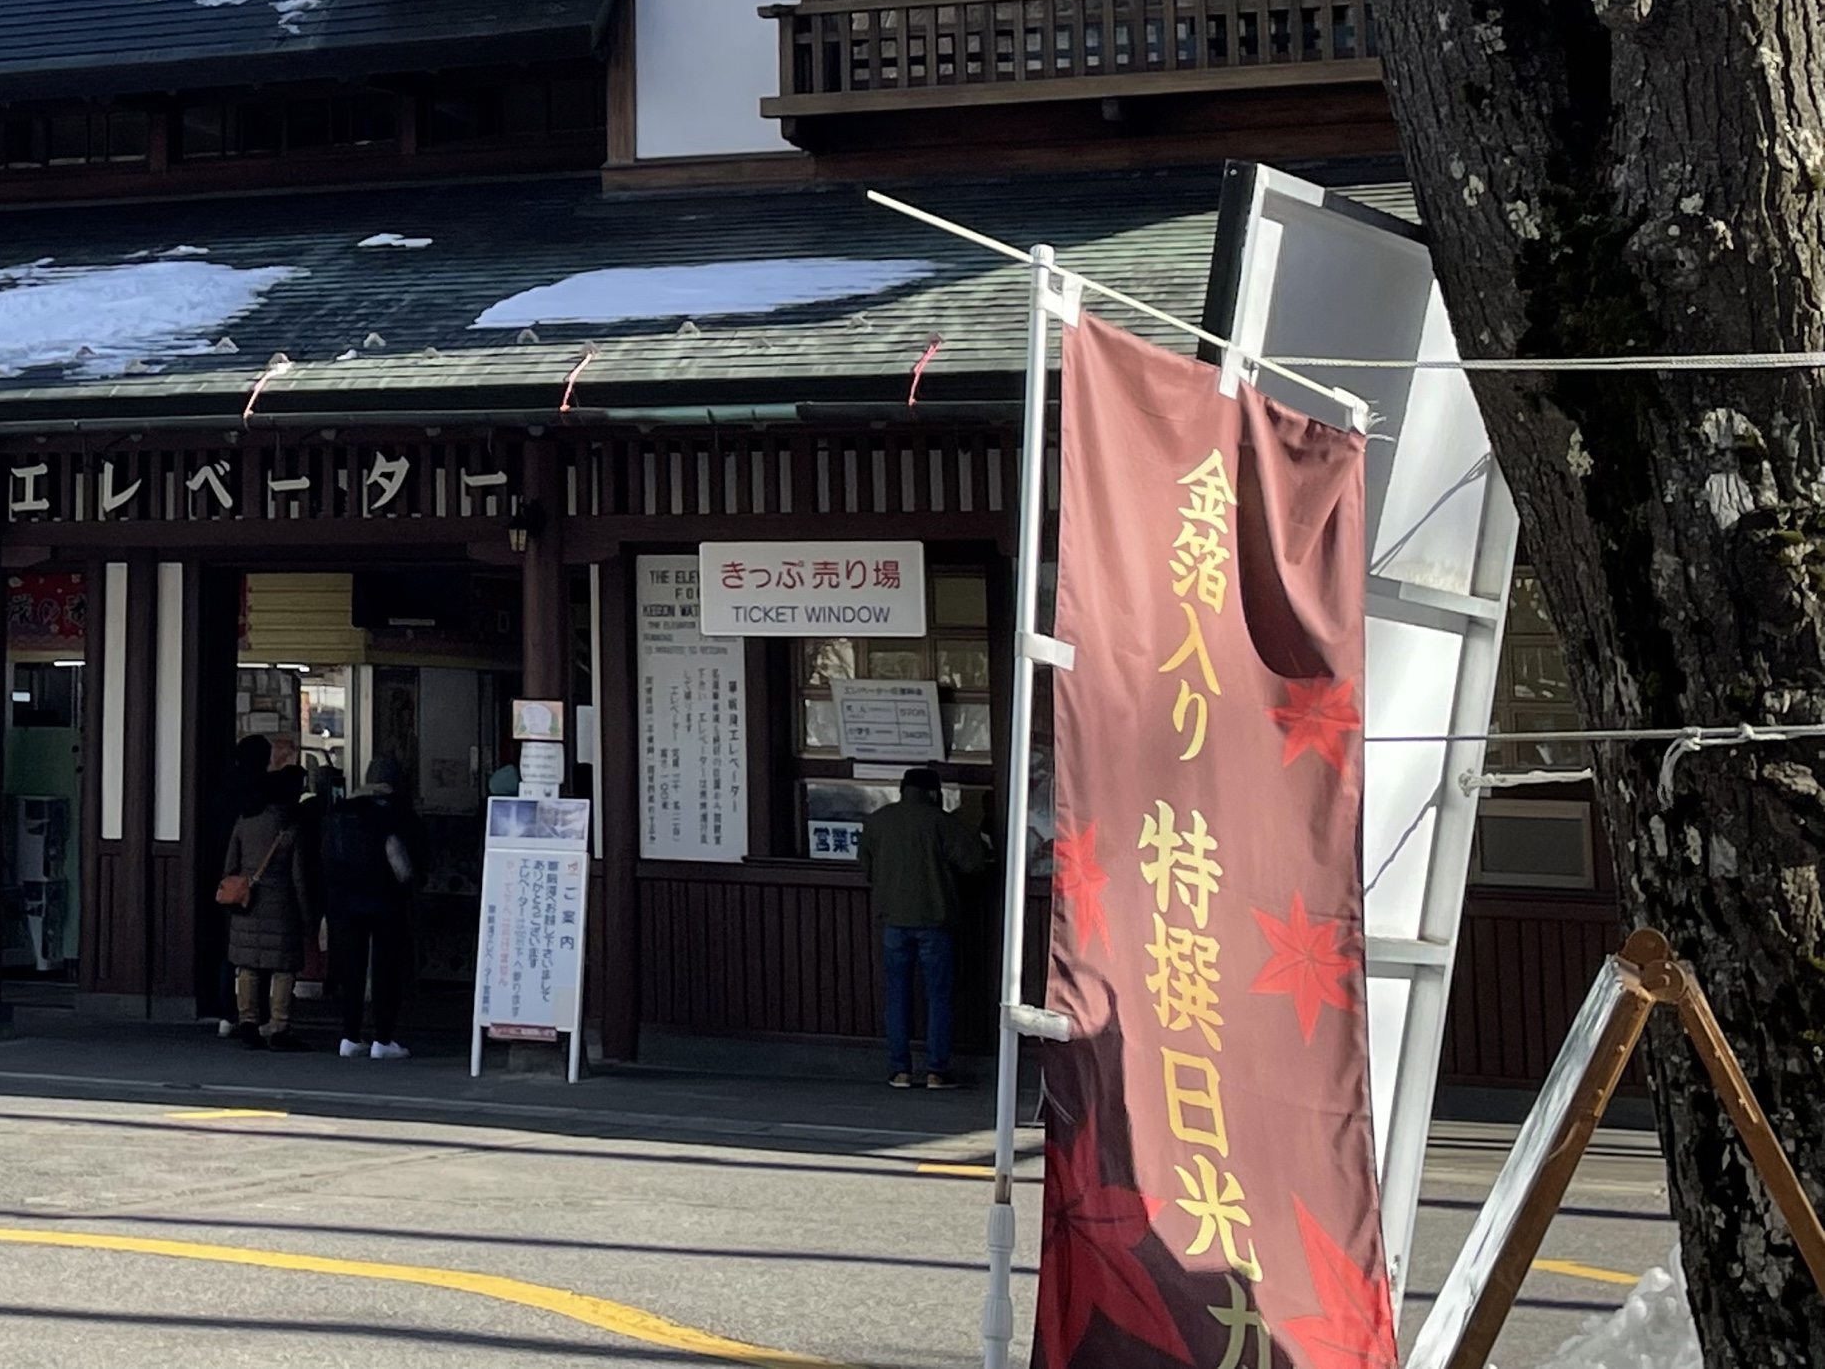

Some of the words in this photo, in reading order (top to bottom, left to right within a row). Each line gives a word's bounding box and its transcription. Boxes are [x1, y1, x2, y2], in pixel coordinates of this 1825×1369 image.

[649, 570, 670, 584] THE
[675, 570, 700, 584] ELE
[721, 560, 900, 590] きっぷ売り場
[675, 588, 700, 600] FO
[679, 604, 700, 617] WAT
[1158, 448, 1237, 761] 金箔入り
[731, 606, 799, 623] TICKET
[804, 606, 891, 623] WINDOW
